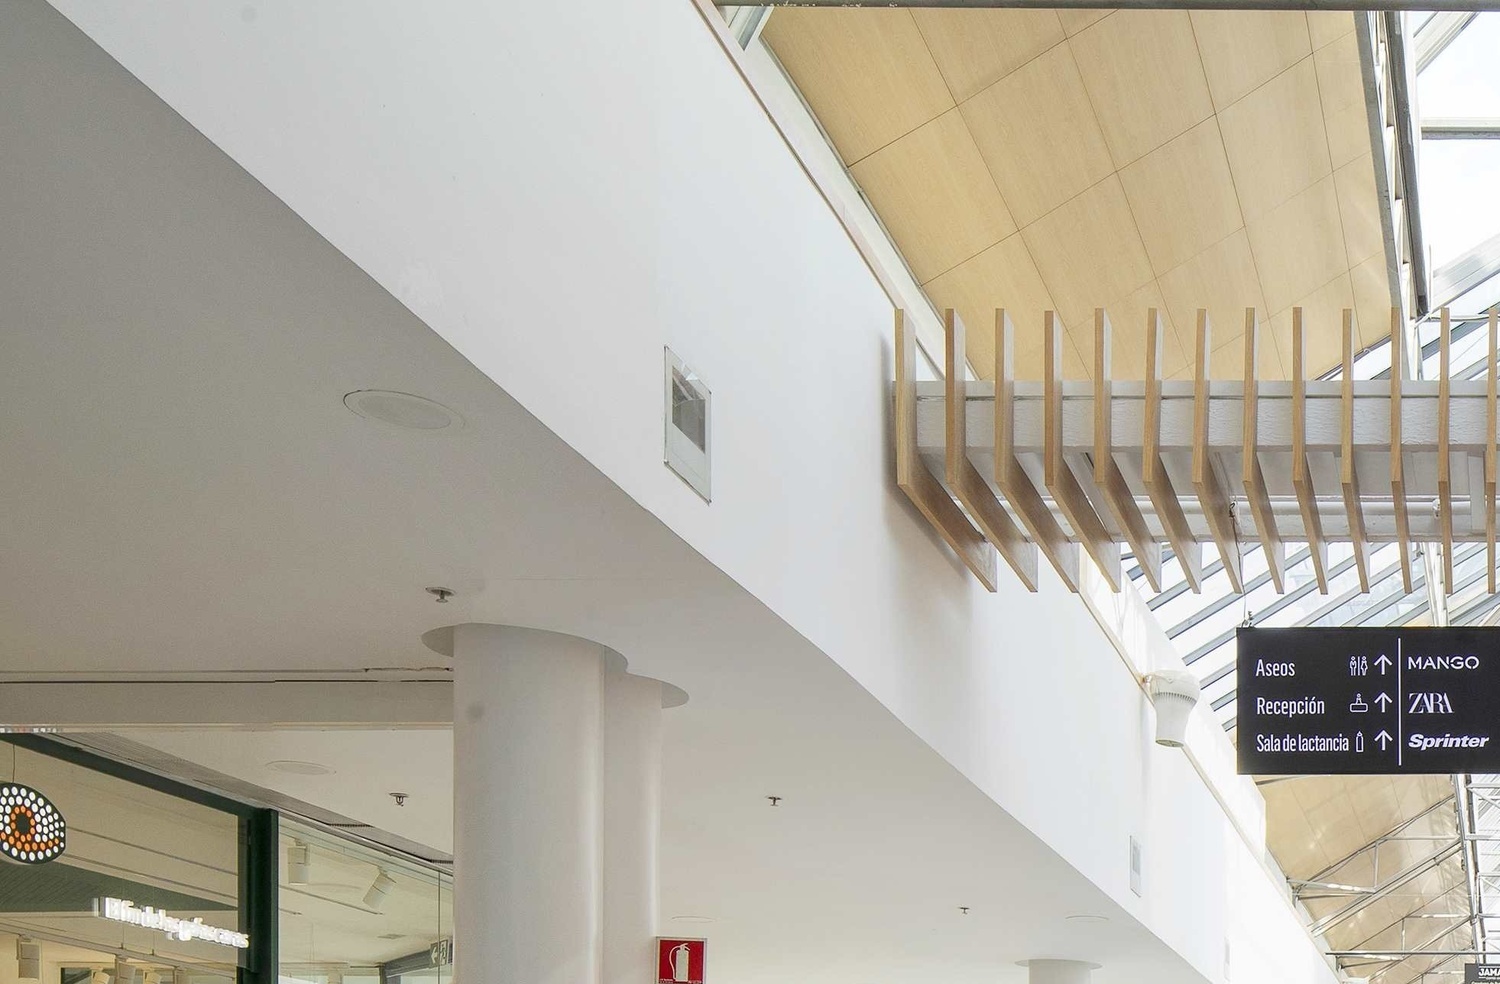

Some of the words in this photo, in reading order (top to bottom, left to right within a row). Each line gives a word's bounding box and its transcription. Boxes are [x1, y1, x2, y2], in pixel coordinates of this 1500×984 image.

[1255, 658, 1296, 677] Aseos
[1408, 655, 1480, 670] MANGO
[1256, 696, 1325, 718] Recepción
[1408, 692, 1453, 714] ZARA
[1256, 733, 1281, 753] Sala
[1282, 733, 1297, 752] de
[1298, 733, 1350, 752] lactancia
[1408, 733, 1490, 751] Sprinter
